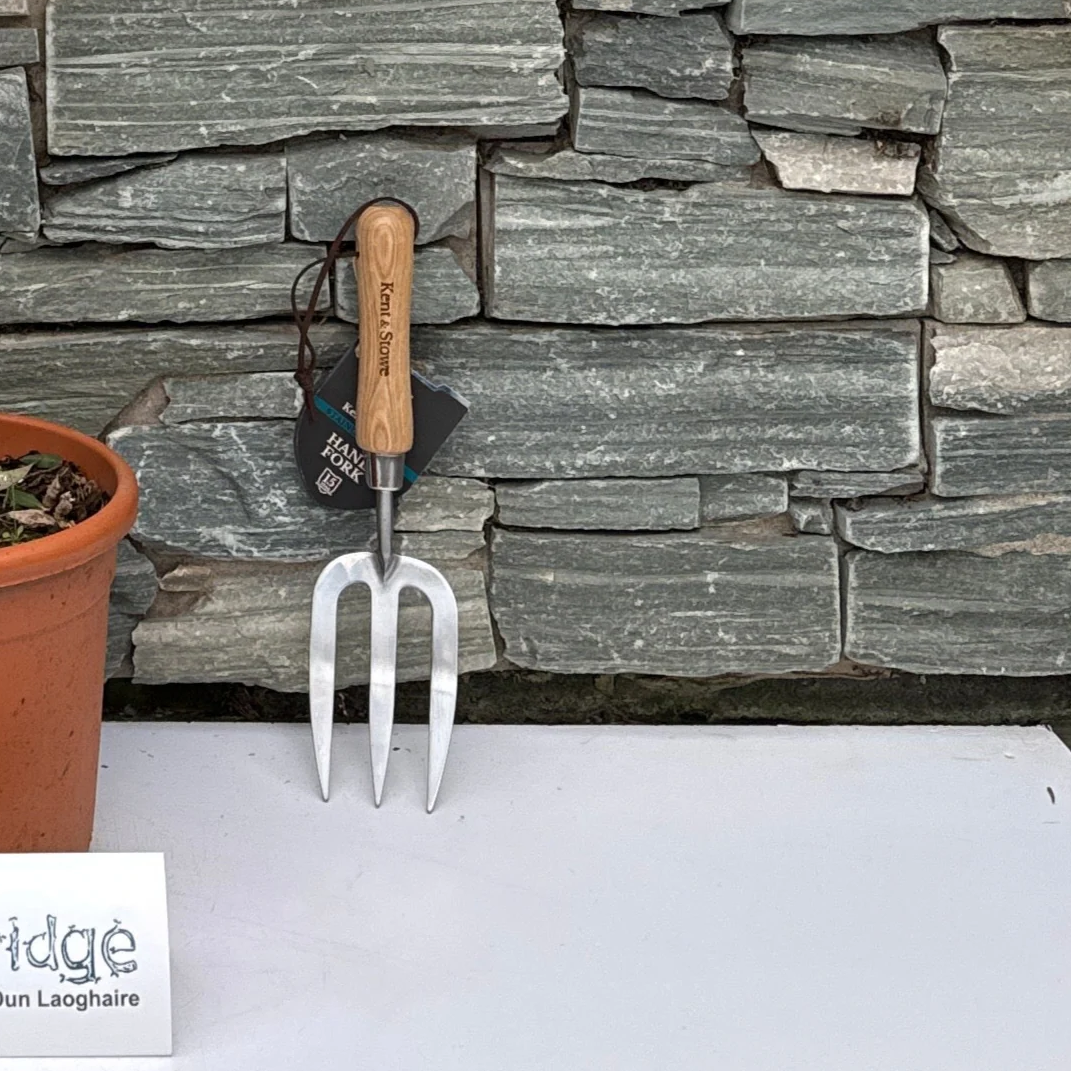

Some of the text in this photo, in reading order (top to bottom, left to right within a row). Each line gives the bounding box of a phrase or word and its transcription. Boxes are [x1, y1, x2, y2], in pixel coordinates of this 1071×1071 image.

[379, 282, 394, 377] Kent & Stowe
[320, 445, 364, 484] FORK
[38, 989, 140, 1011] Laoghaire
